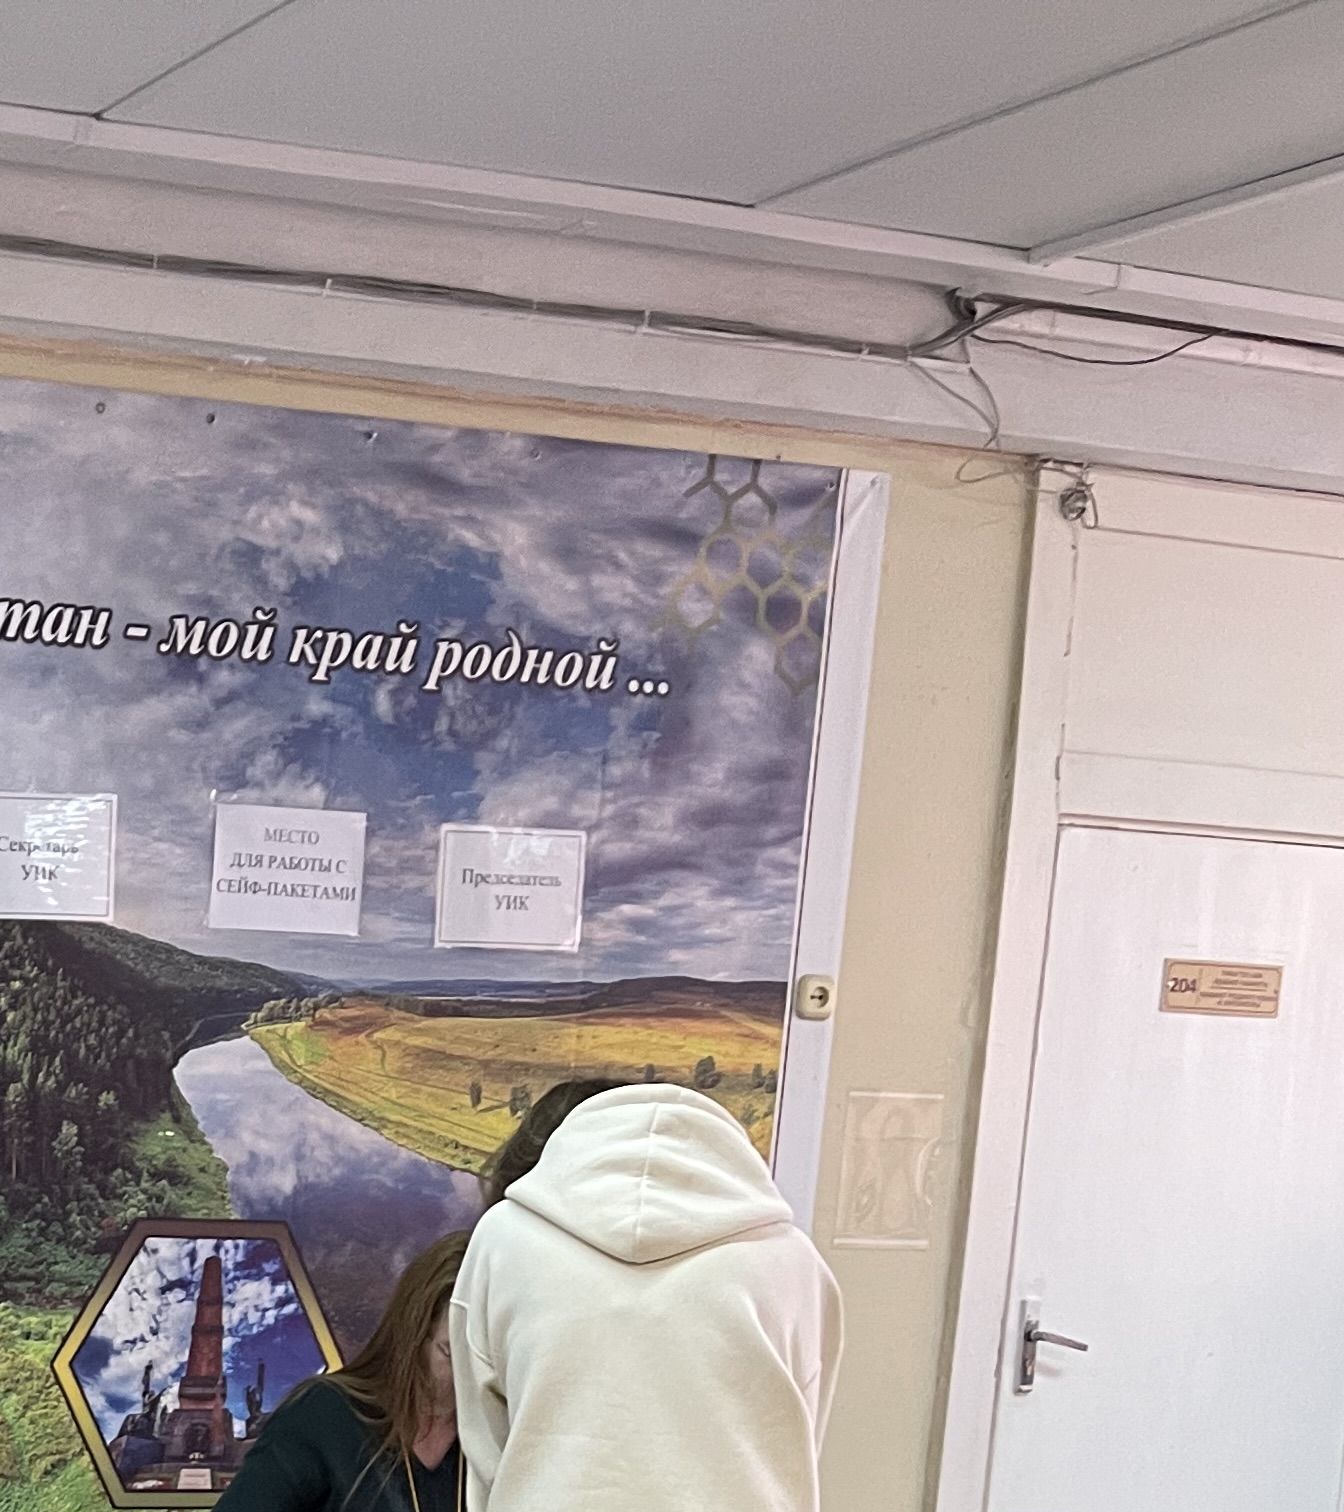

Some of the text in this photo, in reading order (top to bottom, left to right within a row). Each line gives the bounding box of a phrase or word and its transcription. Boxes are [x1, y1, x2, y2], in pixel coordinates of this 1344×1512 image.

[159, 607, 277, 662] мой
[288, 622, 419, 684] край
[423, 630, 620, 693] родной
[264, 828, 320, 845] МЕСТО
[21, 864, 61, 881] УИК
[230, 853, 347, 874] ДЛЯ РАБОТЫ С
[461, 868, 562, 888] Председатель
[216, 876, 357, 901] СЕЙФ-ПАКЕТАМИ
[495, 895, 530, 911] УИК
